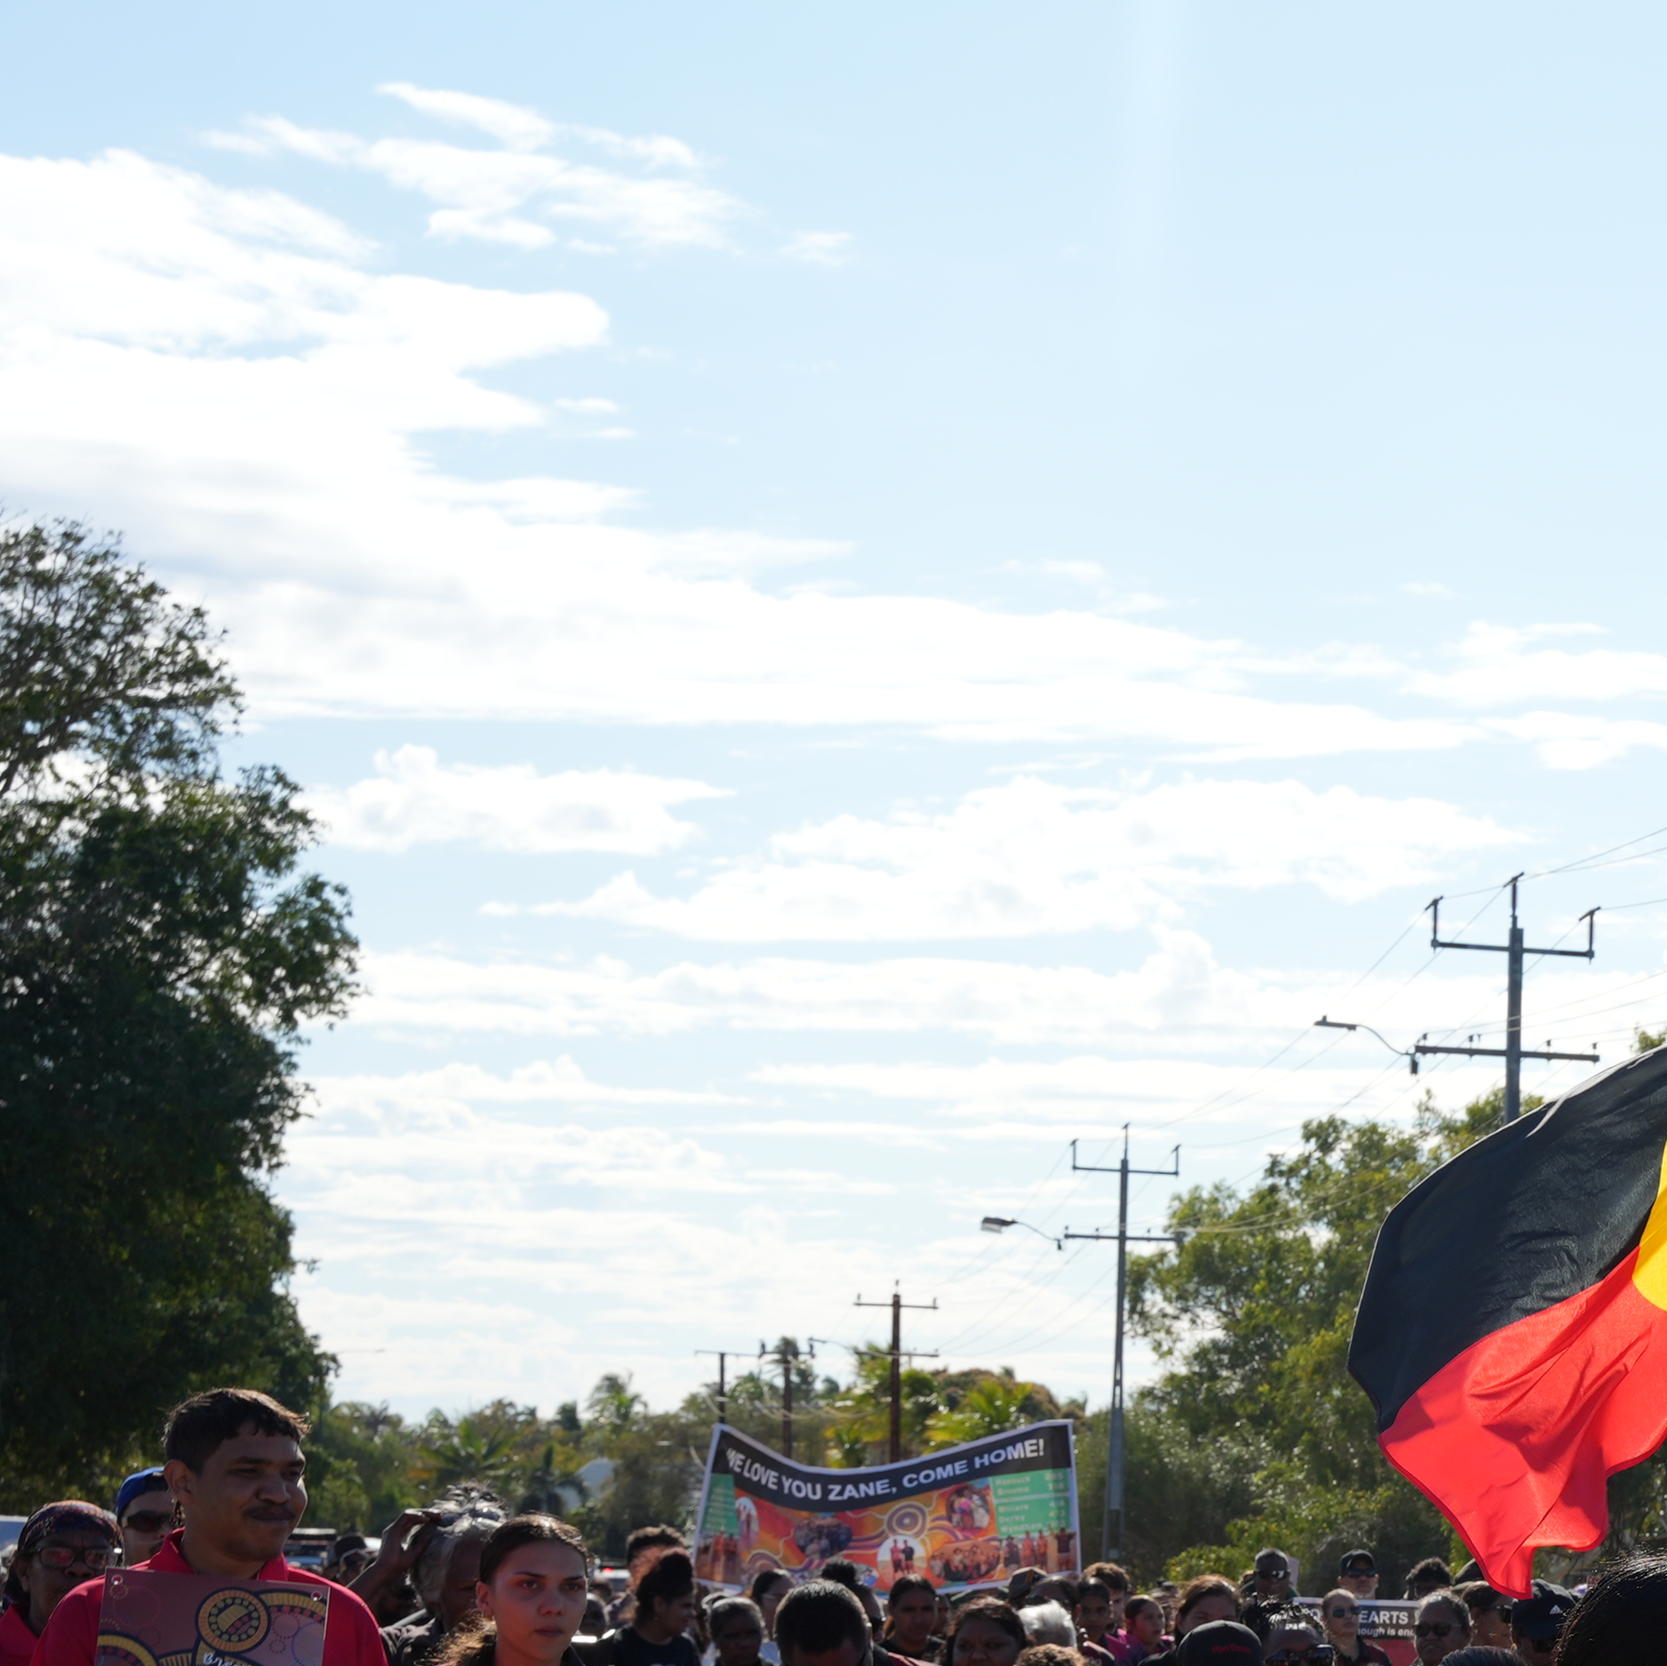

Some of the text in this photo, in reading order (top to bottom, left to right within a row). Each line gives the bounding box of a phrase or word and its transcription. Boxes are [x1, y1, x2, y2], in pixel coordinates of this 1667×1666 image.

[743, 1461, 779, 1490] LOVE
[781, 1474, 822, 1500] YOU
[827, 1479, 897, 1500] ZANE,
[903, 1460, 969, 1489] COME
[974, 1438, 1045, 1469] HOME!
[1358, 1610, 1409, 1626] EARTS
